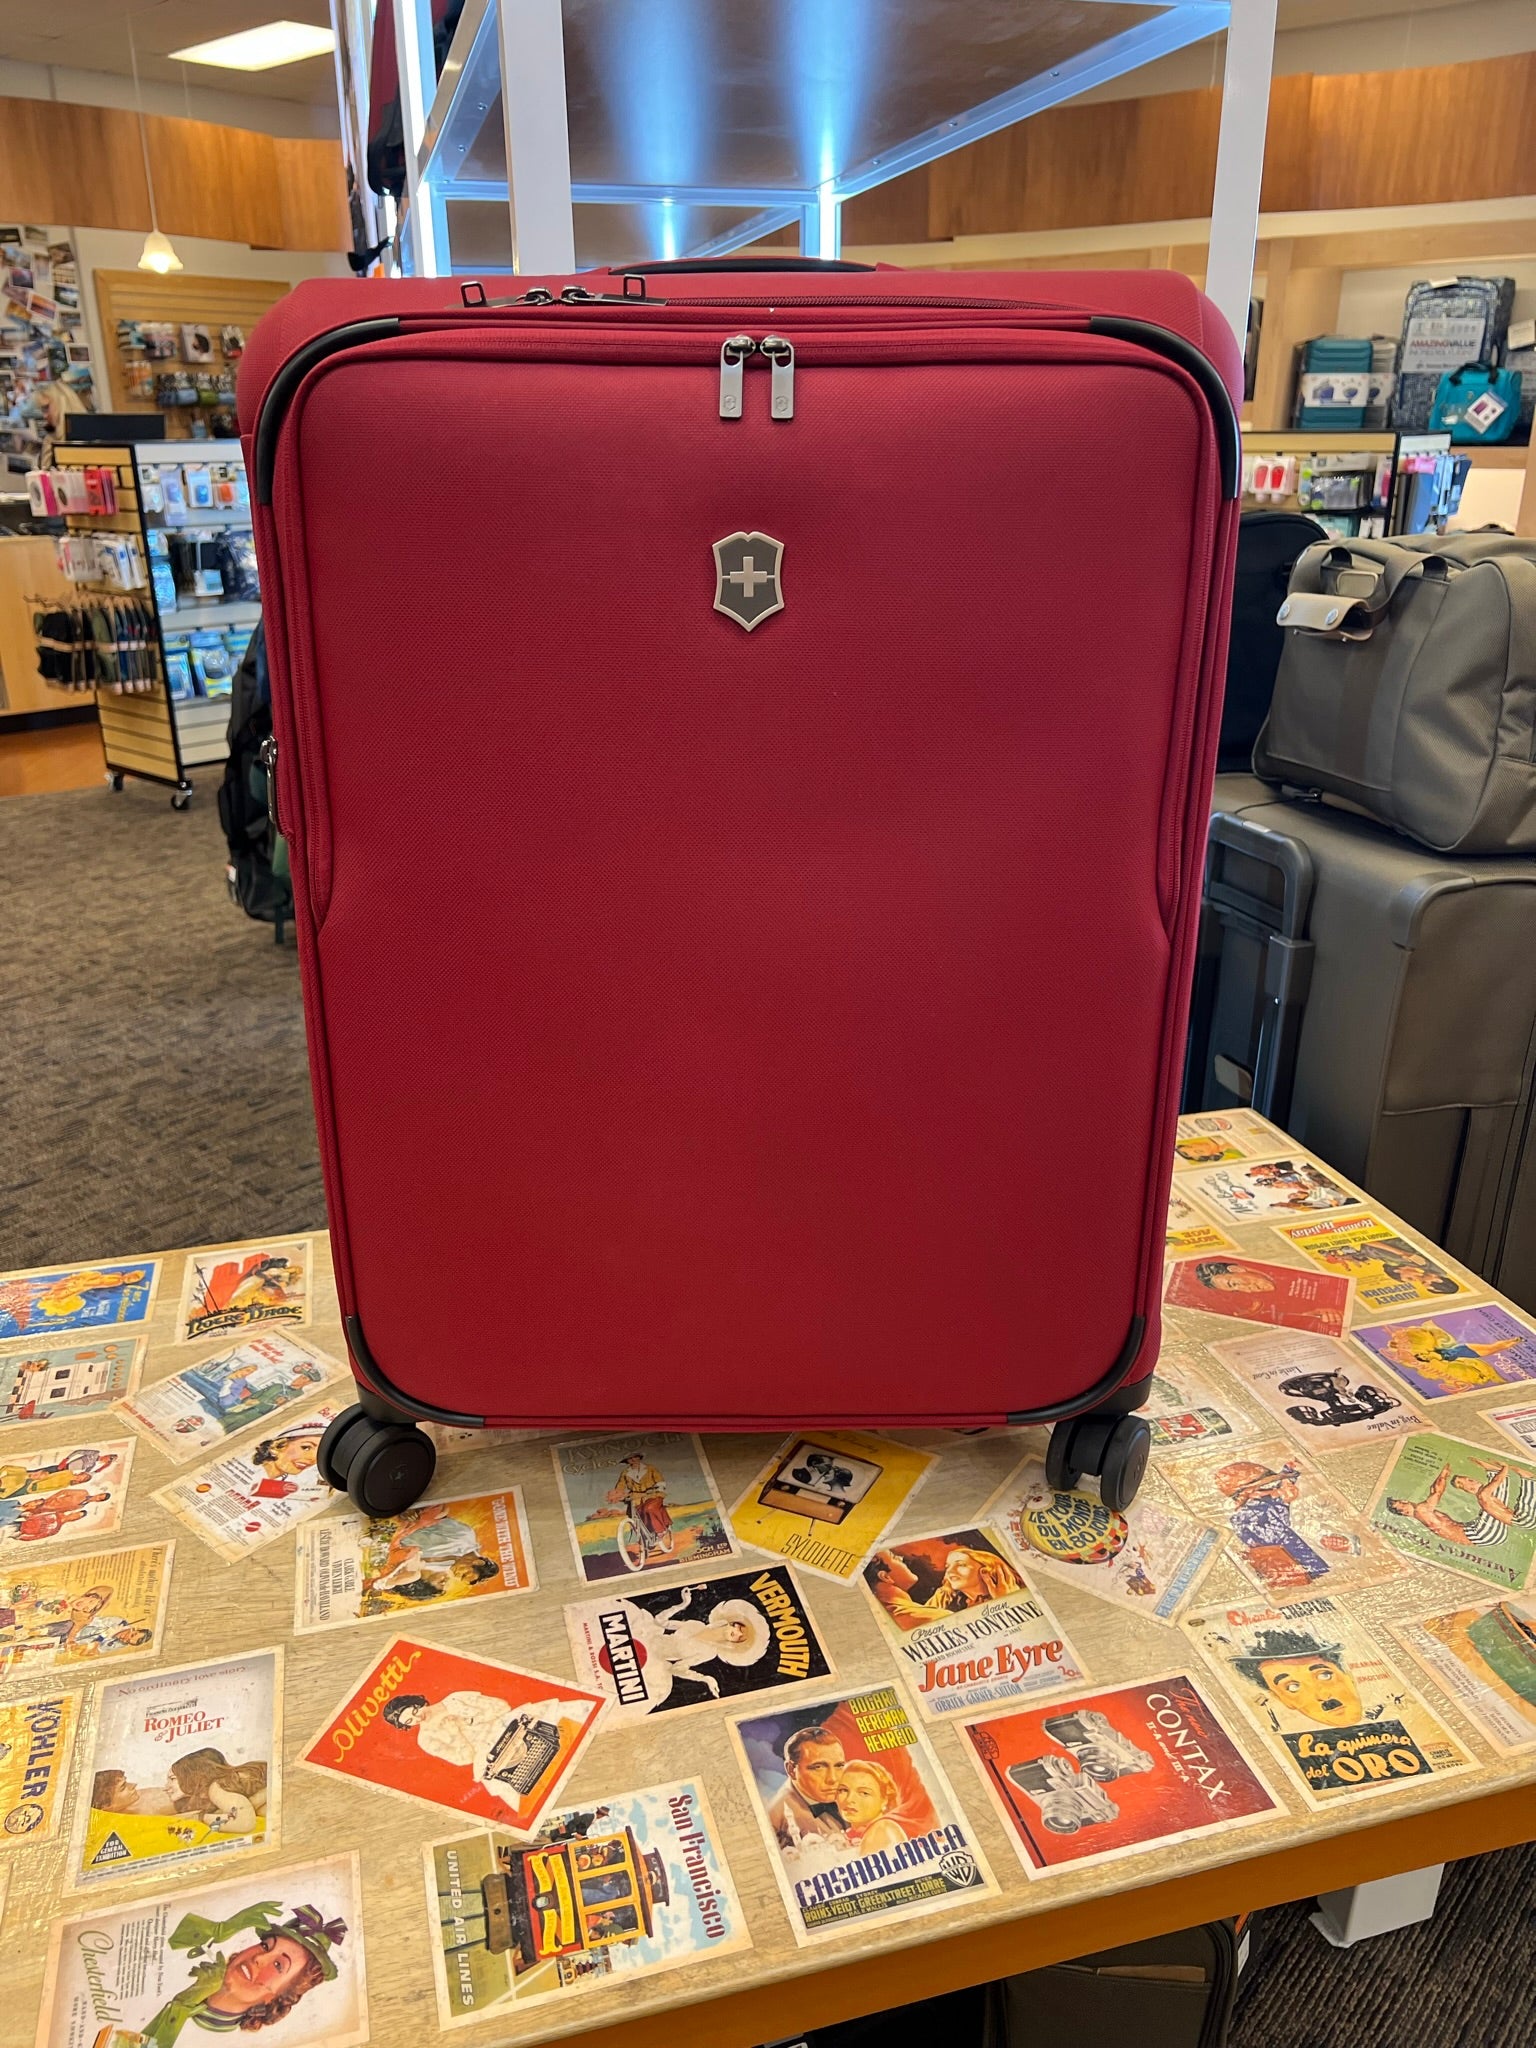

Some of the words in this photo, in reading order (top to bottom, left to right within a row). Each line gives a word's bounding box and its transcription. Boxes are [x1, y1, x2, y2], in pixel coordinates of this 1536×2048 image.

[1290, 1221, 1334, 1239] Holiday
[1333, 1219, 1374, 1234] Roman
[1361, 1284, 1415, 1297] HEPBURN
[1375, 1291, 1419, 1305] AUDREY
[1367, 1421, 1392, 1431] Value
[562, 1457, 618, 1475] Cycles
[1029, 1510, 1044, 1524] LE
[1049, 1493, 1074, 1519] TOUR
[1037, 1521, 1058, 1538] DU
[1057, 1498, 1090, 1536] MONDE
[1050, 1536, 1070, 1551] EN
[1070, 1531, 1097, 1550] 80
[1437, 1541, 1521, 1583] AMERICAN
[981, 1601, 1010, 1617] Joan
[1226, 1608, 1281, 1627] Charlie
[1281, 1600, 1336, 1621] CHAPLIN
[750, 1571, 811, 1678] VERMOUTH
[900, 1628, 969, 1662] WELLES
[967, 1601, 1044, 1639] FONTAINE
[910, 1624, 945, 1642] Orson
[601, 1613, 645, 1702] MARTINI
[918, 1655, 993, 1694] Jane
[994, 1640, 1064, 1682] Eyre
[118, 1687, 136, 1698] No
[136, 1675, 192, 1693] ordinary
[194, 1670, 220, 1682] love
[220, 1664, 247, 1676] story
[332, 1650, 422, 1763] Olivetti
[850, 1687, 897, 1714] BOGART
[144, 1710, 206, 1733] ROMEO
[154, 1731, 168, 1743] &
[165, 1716, 225, 1743] JULIET
[856, 1707, 909, 1734] BERGMAN
[863, 1727, 918, 1754] HENREID
[1147, 1693, 1231, 1801] CONTAX
[1298, 1734, 1333, 1758] La
[1336, 1731, 1412, 1754] quimera
[1305, 1763, 1330, 1780] del
[1333, 1749, 1421, 1782] ORO
[95, 1849, 129, 1863] EXHIBITION
[100, 1844, 124, 1854] GENERAL
[106, 1839, 119, 1848] FOR
[667, 1794, 693, 1831] San
[682, 1831, 726, 1940] Francisco
[794, 1823, 968, 1908] CASABLANCA
[446, 1850, 463, 1909] UNITED
[803, 1904, 831, 1922] RAINS
[831, 1897, 857, 1916] VEIDT
[858, 1886, 916, 1911] GREENSTREET
[916, 1877, 946, 1895] LORRE
[454, 1916, 468, 1946] AIR
[77, 1929, 123, 2023] Chesterfield
[457, 1952, 474, 2006] LINES
